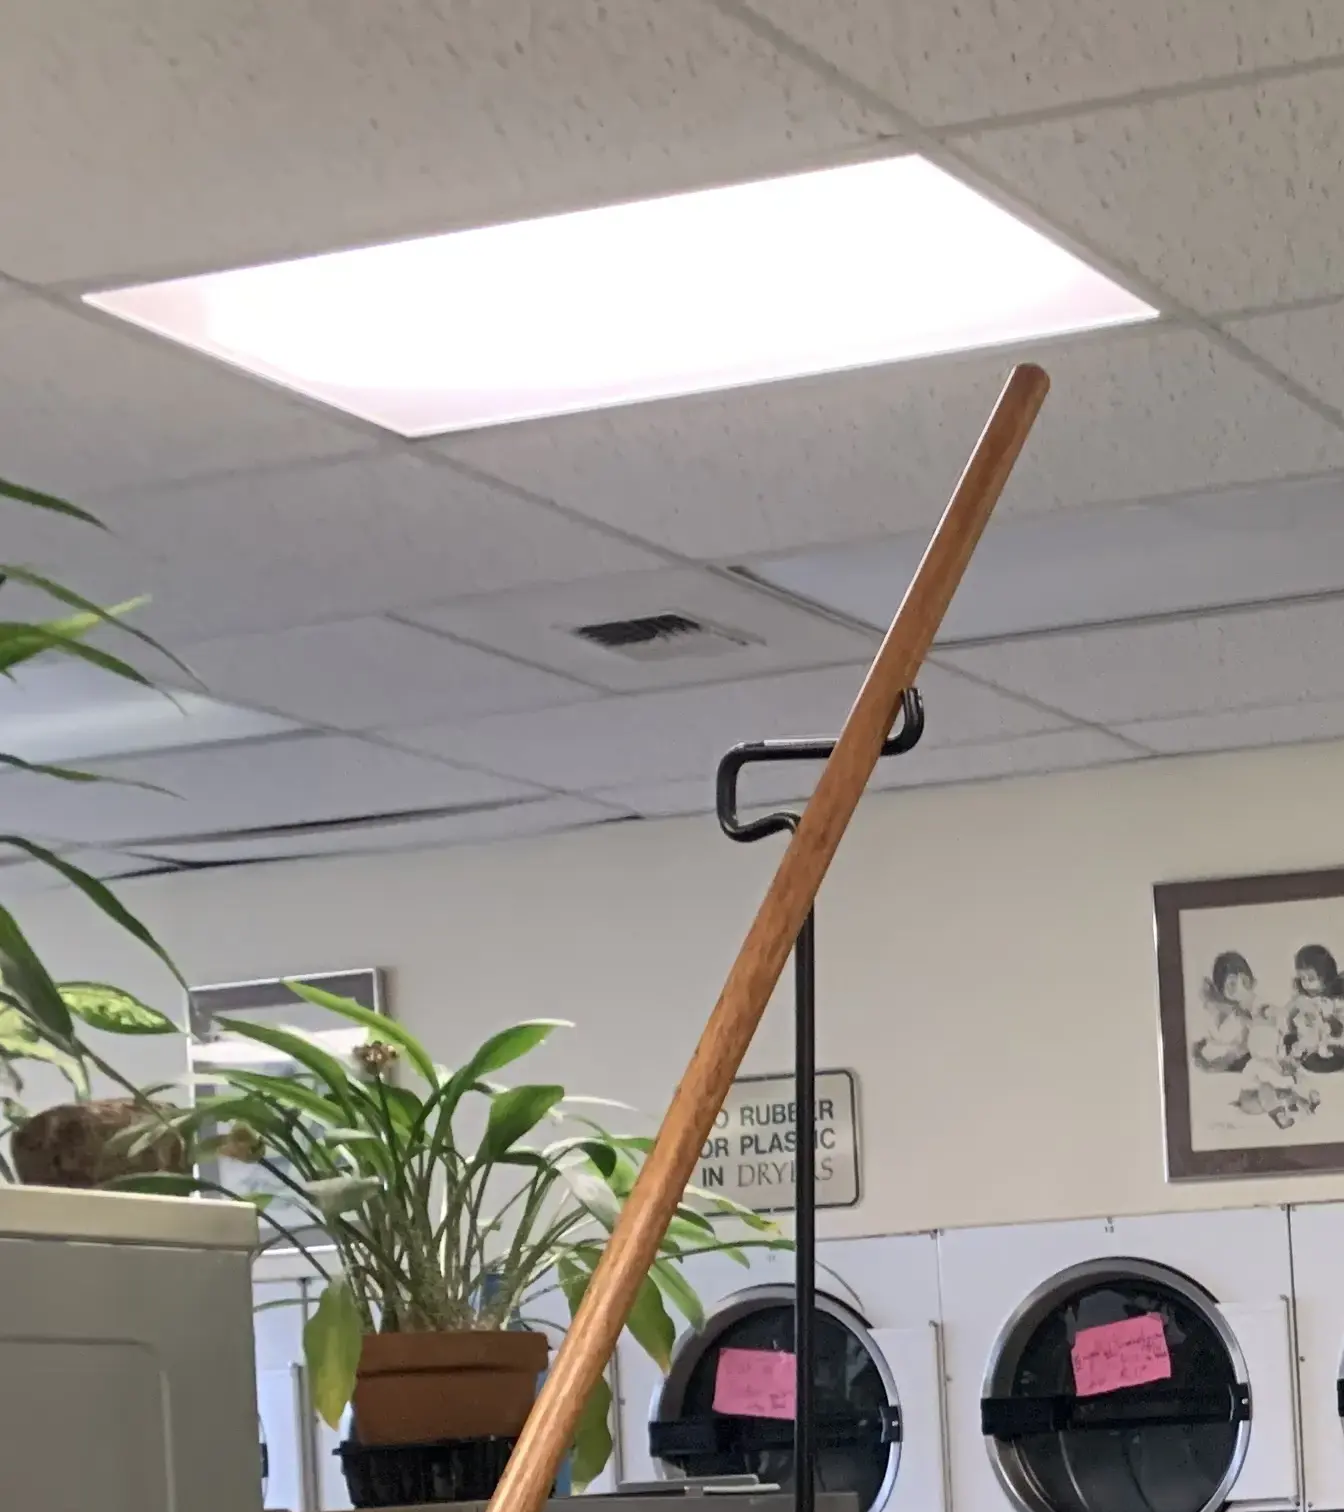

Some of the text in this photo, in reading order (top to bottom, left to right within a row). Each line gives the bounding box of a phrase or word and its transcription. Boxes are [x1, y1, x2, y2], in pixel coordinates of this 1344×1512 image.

[739, 1098, 834, 1127] RUBBR
[739, 1127, 837, 1157] PLASIC
[701, 1156, 834, 1188] IN DRYS
